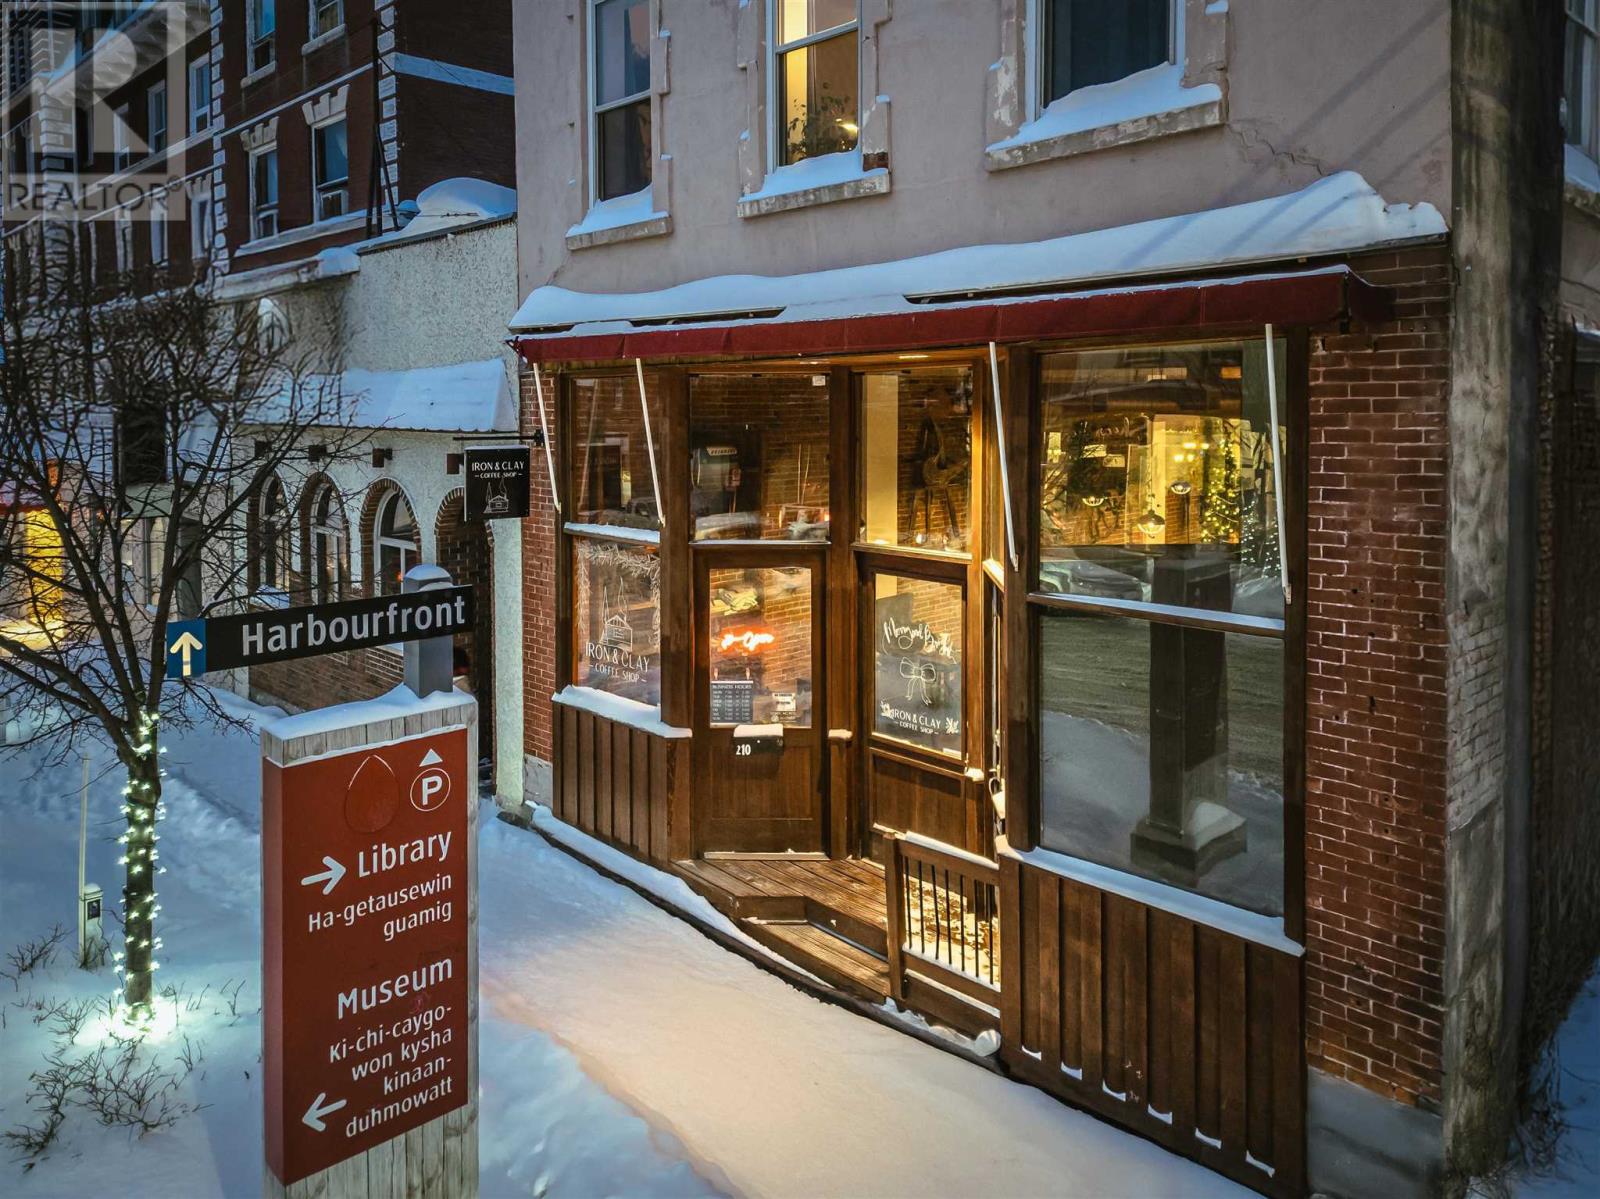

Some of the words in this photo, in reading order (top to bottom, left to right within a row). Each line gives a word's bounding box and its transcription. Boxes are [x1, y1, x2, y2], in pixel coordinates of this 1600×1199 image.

[471, 461, 493, 472] IRON
[494, 461, 500, 471] &
[501, 460, 525, 471] CLAY
[242, 595, 466, 656] Harbourfront
[585, 640, 610, 662] IRON
[612, 648, 619, 665] &
[621, 650, 650, 673] CLAY
[595, 662, 620, 679] COFFEE
[622, 670, 640, 683] SHOP
[889, 708, 911, 722] IRON
[912, 714, 918, 724] &
[919, 715, 941, 729] CLAY
[899, 720, 918, 731] COFFEE
[920, 726, 934, 735] SHOP
[735, 743, 752, 756] 210
[421, 775, 443, 806] P
[358, 831, 452, 878] Library
[308, 873, 452, 933] Ha-getausewin
[383, 902, 452, 942] guamig
[337, 958, 453, 1020] Museum
[329, 1005, 452, 1063] Ki-chi-caygo-
[351, 1052, 393, 1081] won
[401, 1028, 452, 1063] kysha
[383, 1057, 452, 1096] kinaan-
[345, 1075, 453, 1138] duhmowatt
